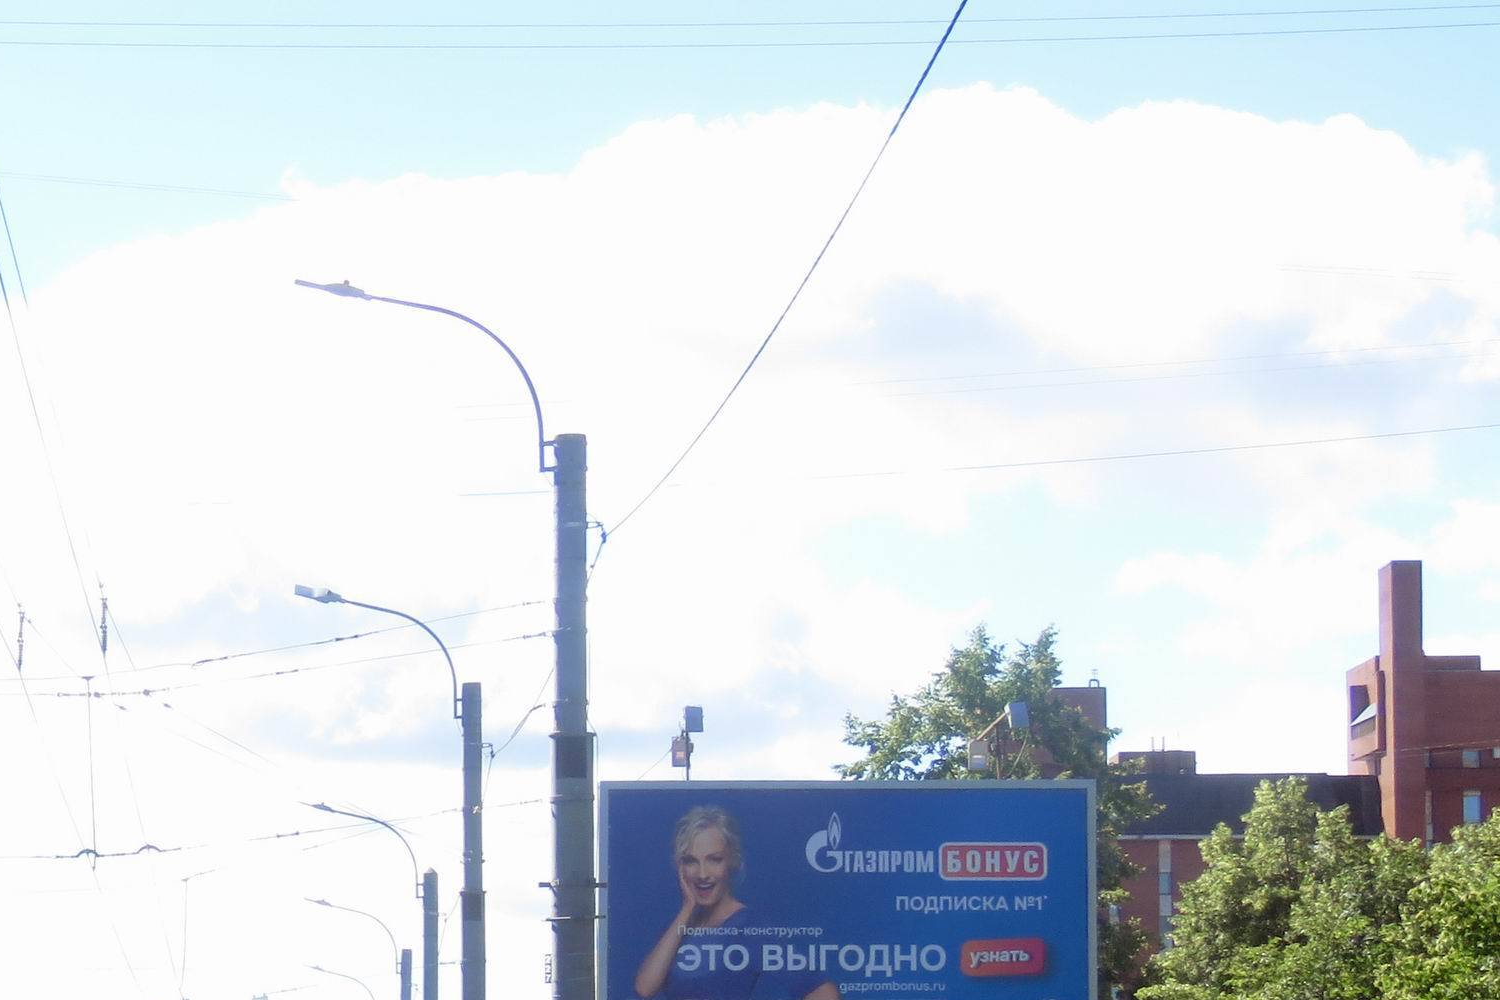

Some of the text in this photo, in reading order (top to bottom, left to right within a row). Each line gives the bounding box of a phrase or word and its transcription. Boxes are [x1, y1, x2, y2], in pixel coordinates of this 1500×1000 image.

[844, 850, 1040, 873] ГАЗПРОМ БОНУС
[895, 895, 1009, 914] ПОДПИСКА
[676, 924, 824, 938] Подписка-конструктор
[676, 943, 947, 978] ЭТО ВЫГОДНО
[969, 948, 1030, 968] узнать
[839, 981, 946, 994] gazprombonus.ru
